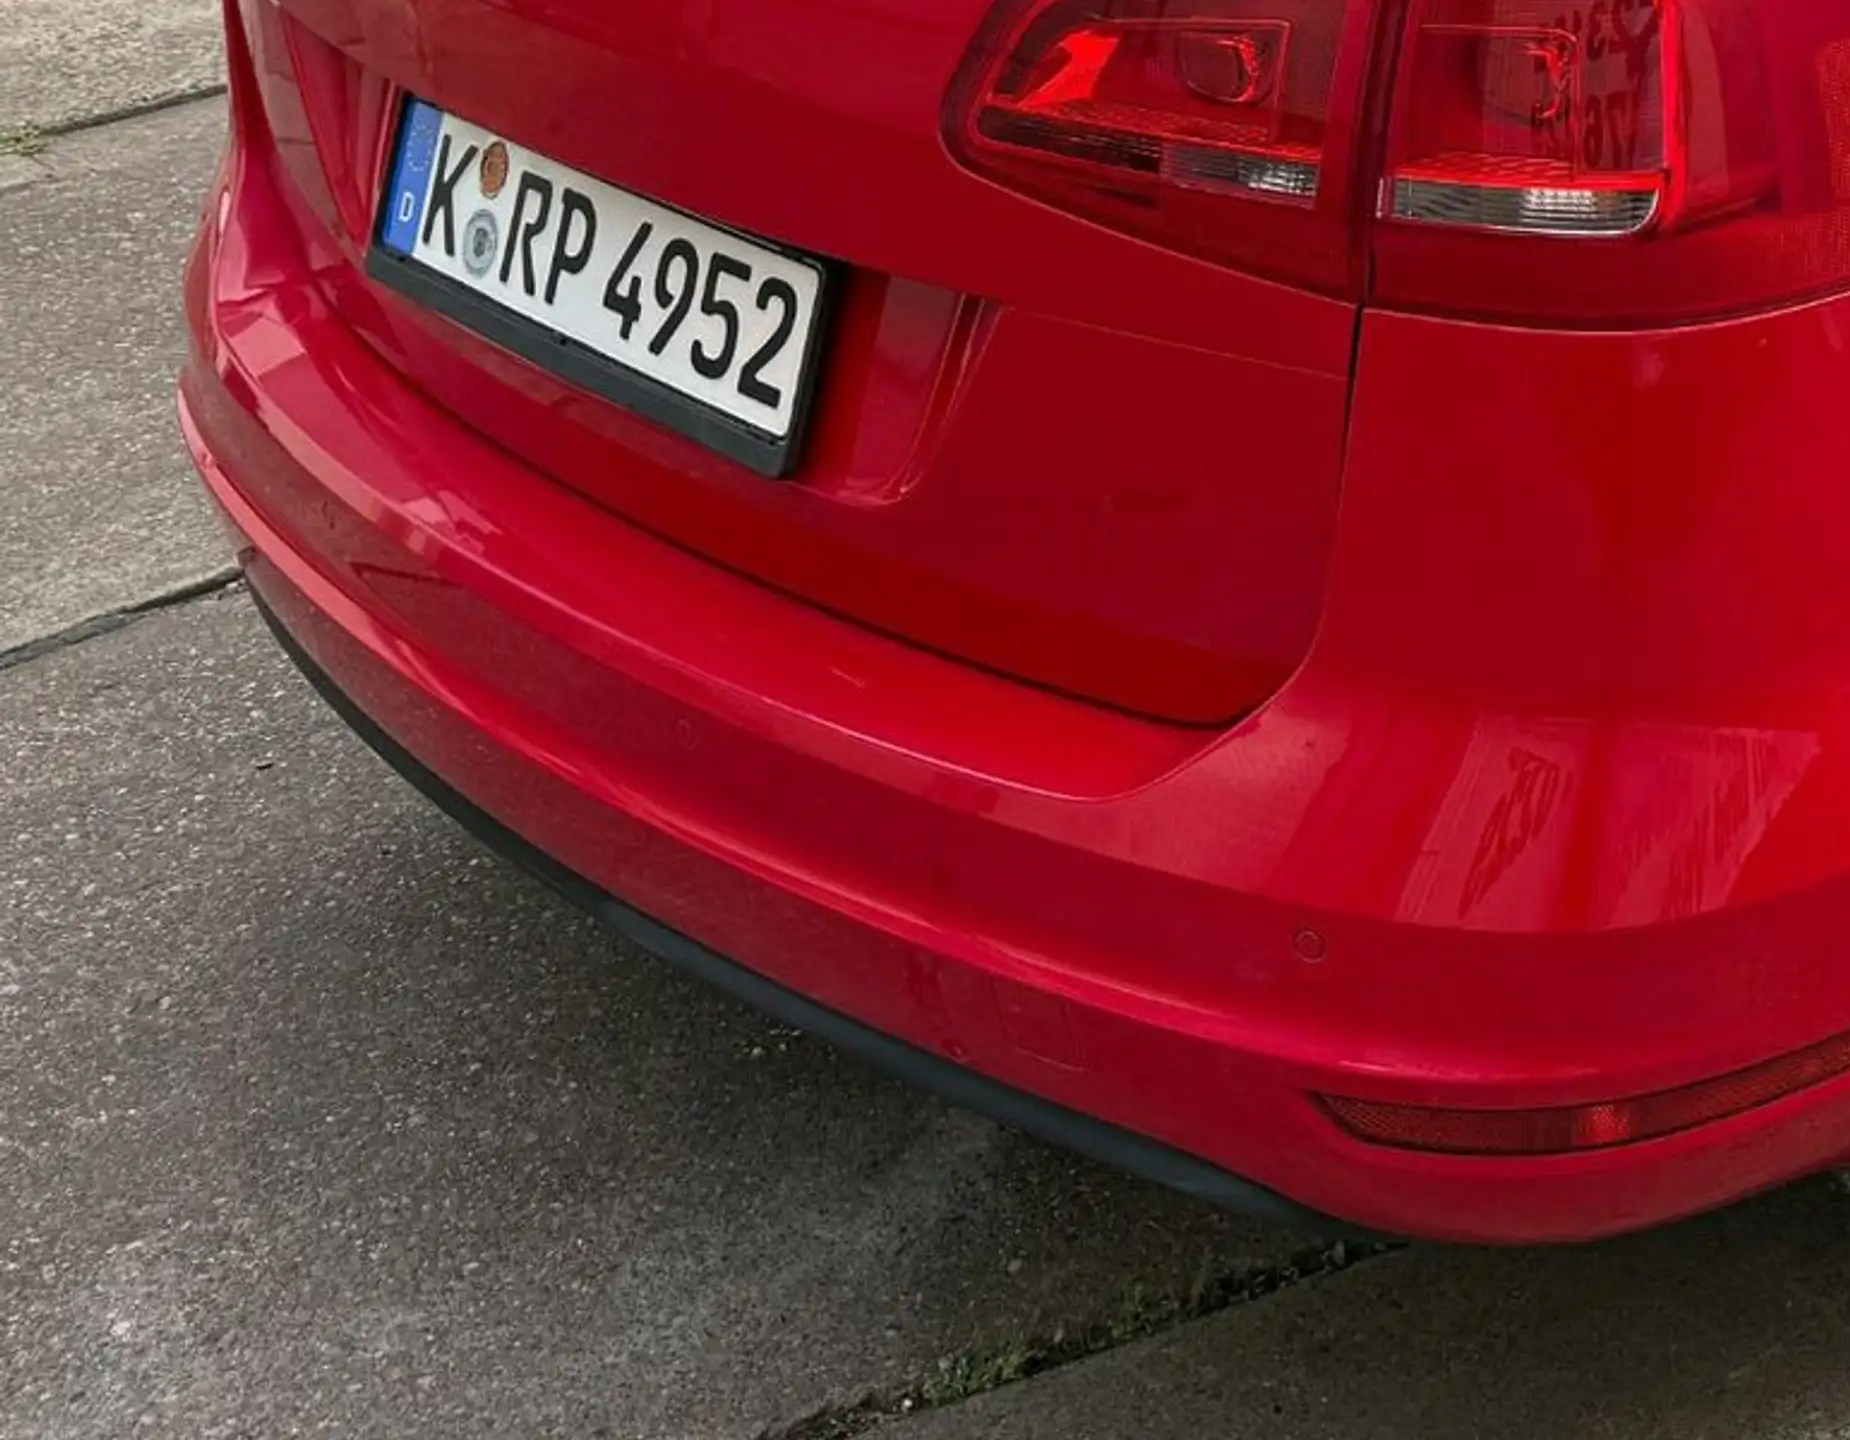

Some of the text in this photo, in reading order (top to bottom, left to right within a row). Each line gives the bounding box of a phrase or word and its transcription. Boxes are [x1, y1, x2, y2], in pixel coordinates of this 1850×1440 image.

[399, 192, 412, 223] D
[422, 133, 799, 409] K RP 4952
